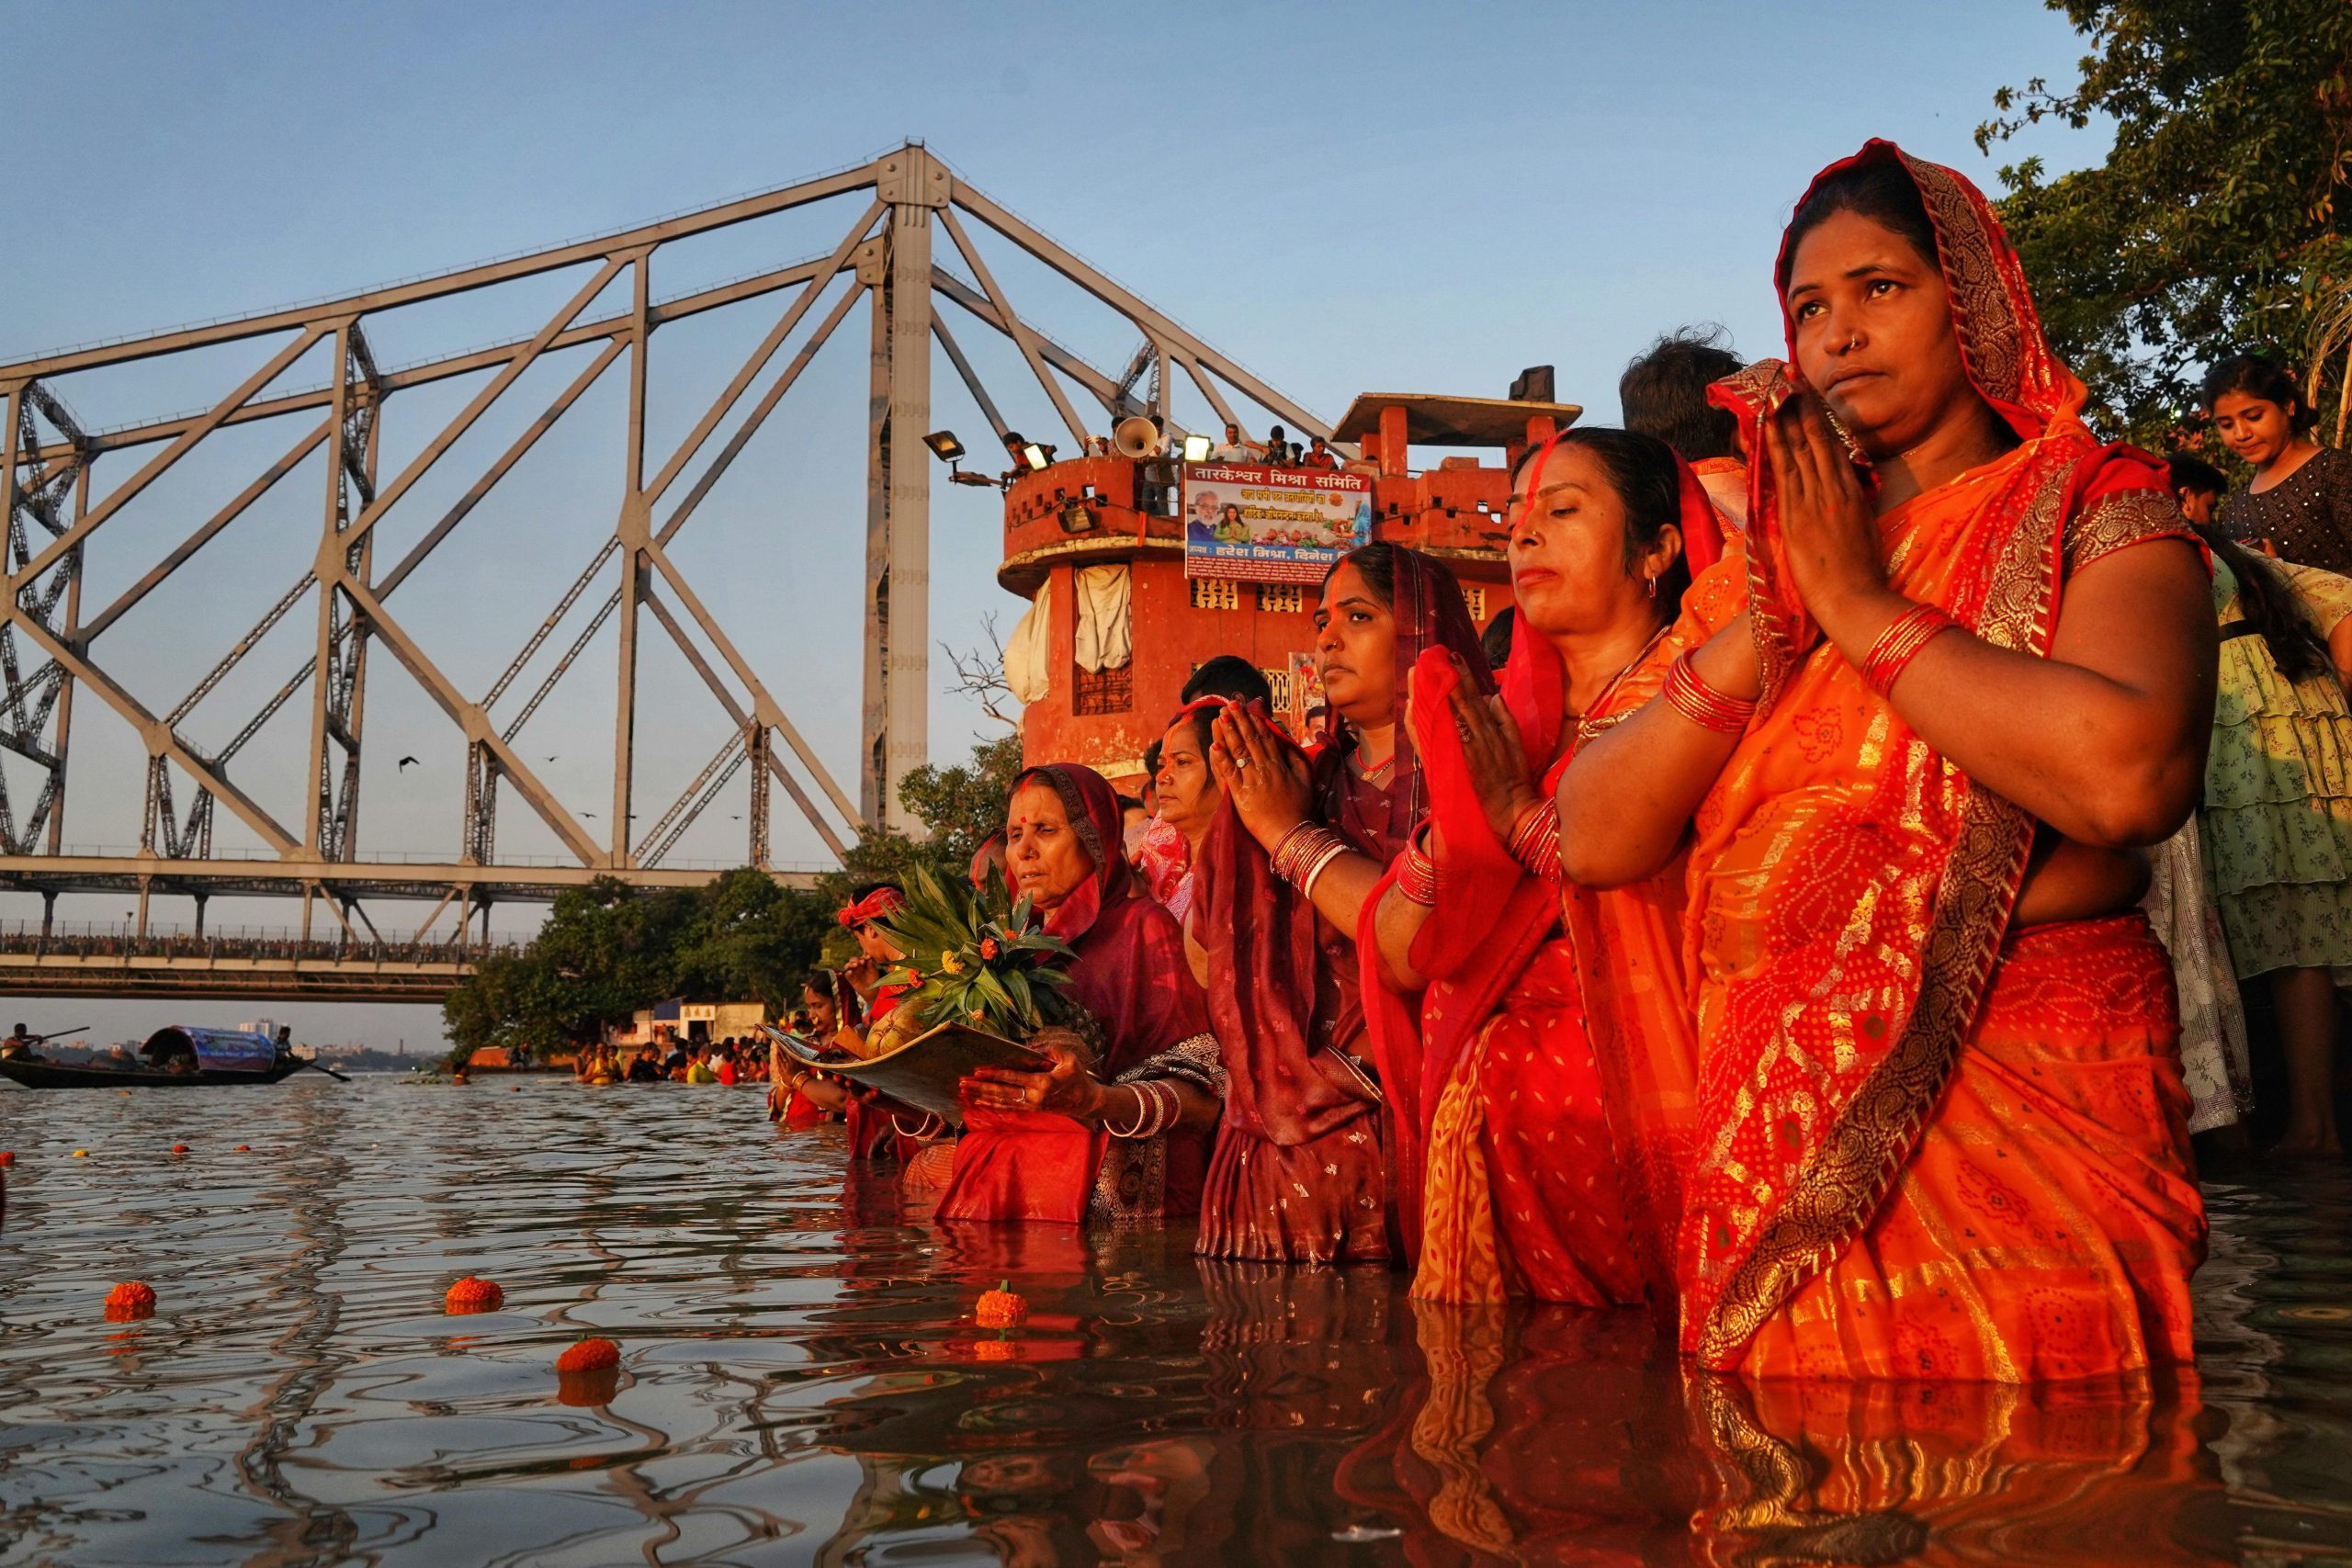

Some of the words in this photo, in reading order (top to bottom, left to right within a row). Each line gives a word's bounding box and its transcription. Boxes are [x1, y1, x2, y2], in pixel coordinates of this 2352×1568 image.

[1195, 466, 1262, 483] तारकेश्वर
[1270, 469, 1307, 486] मिश्रा
[1316, 474, 1362, 490] समिति
[1241, 489, 1255, 500] आप
[1256, 487, 1271, 501] सभी
[1295, 548, 1333, 561] दिनेश
